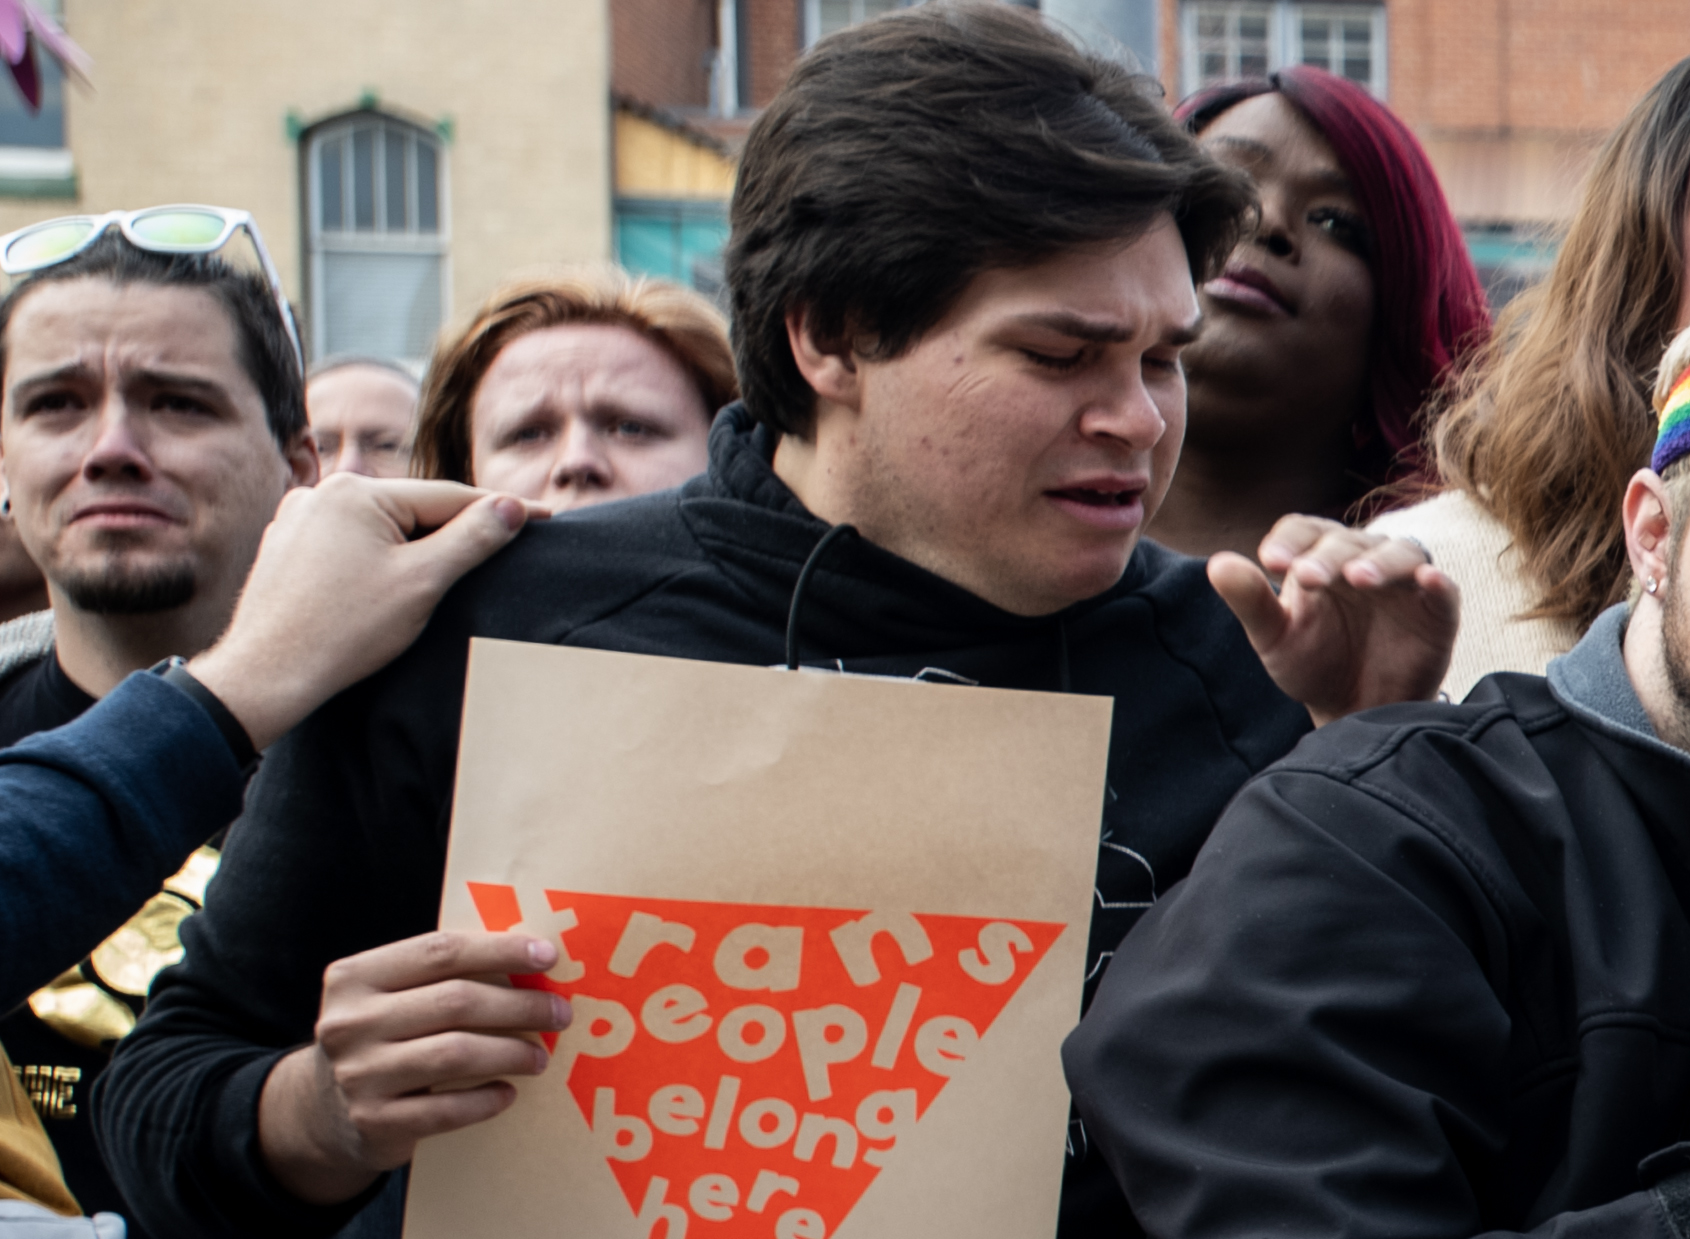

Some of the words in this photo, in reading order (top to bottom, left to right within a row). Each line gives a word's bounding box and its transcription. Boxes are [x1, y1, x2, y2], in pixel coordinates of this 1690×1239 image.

[507, 886, 1035, 993] trans
[551, 982, 982, 1102] people
[591, 1075, 918, 1170] belong
